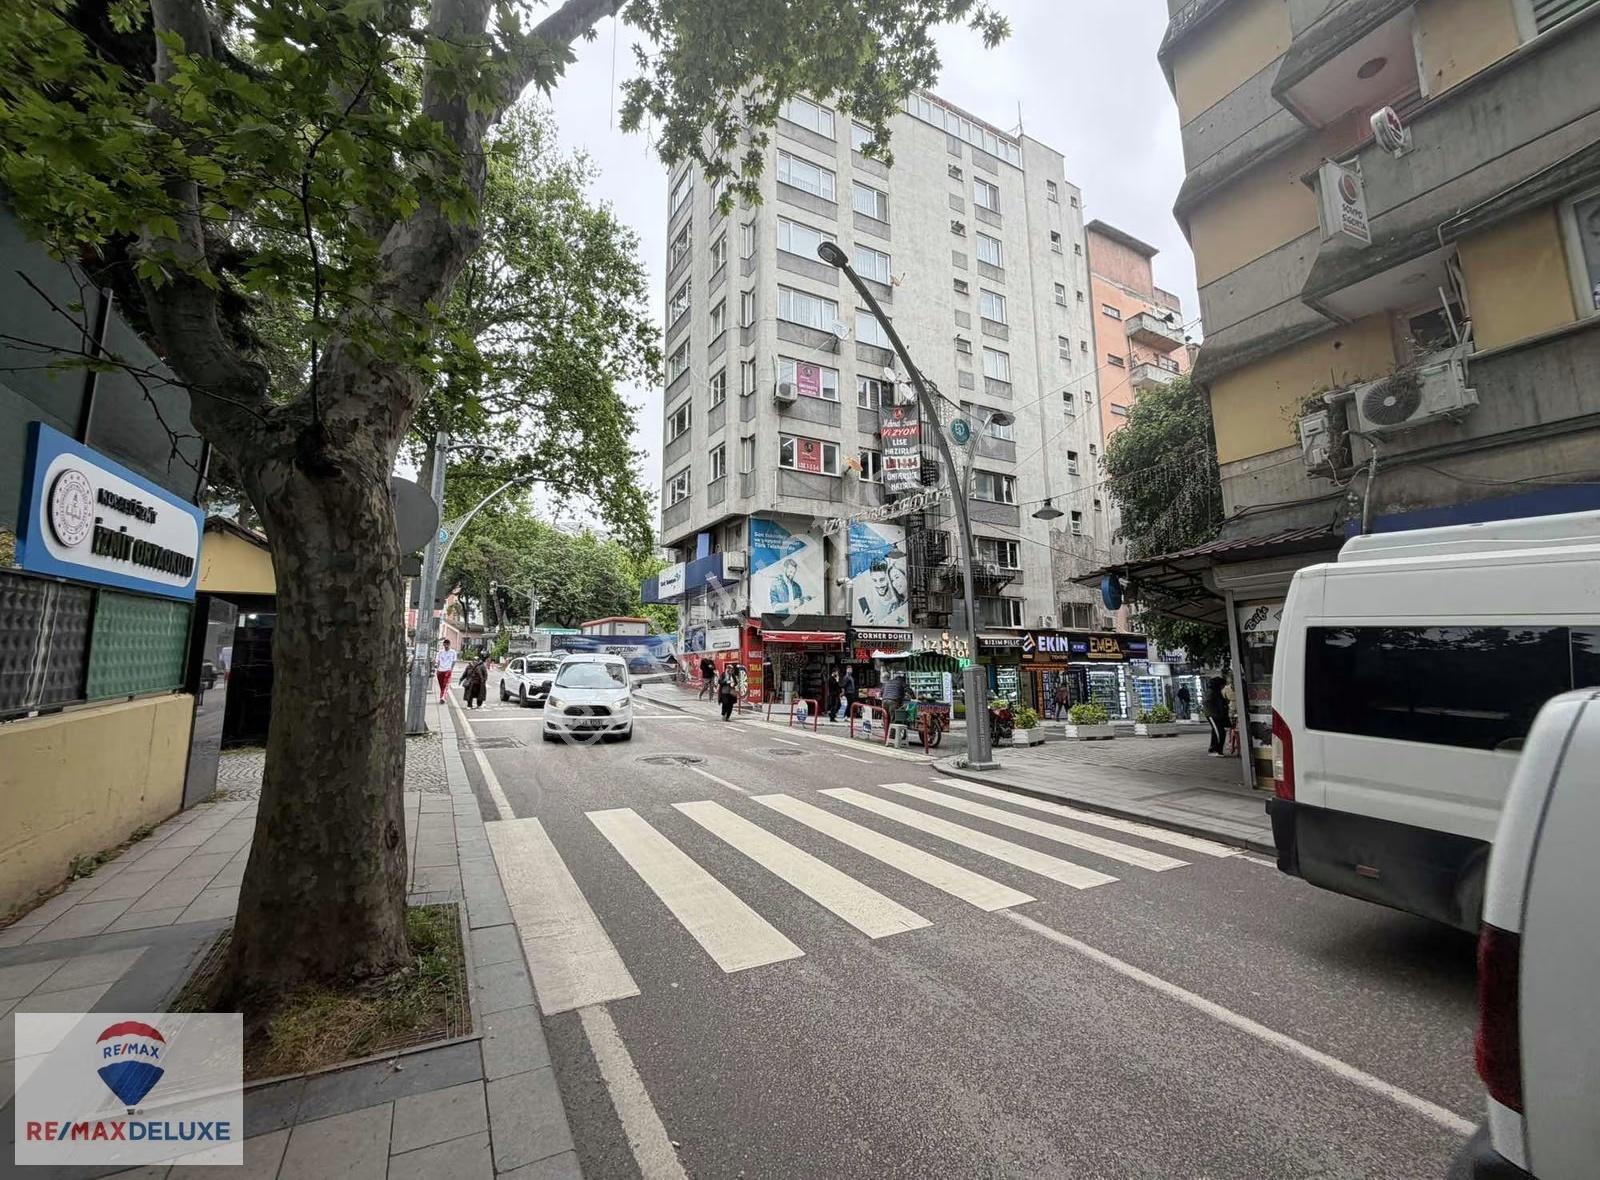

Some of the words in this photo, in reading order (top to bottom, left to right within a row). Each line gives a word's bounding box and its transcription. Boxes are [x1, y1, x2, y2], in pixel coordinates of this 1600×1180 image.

[91, 517, 134, 562] İZMİT
[132, 539, 194, 578] ORTAOKULU
[858, 632, 887, 640] CORNER
[1037, 633, 1069, 652] EKİN
[1089, 637, 1121, 653] EMBA
